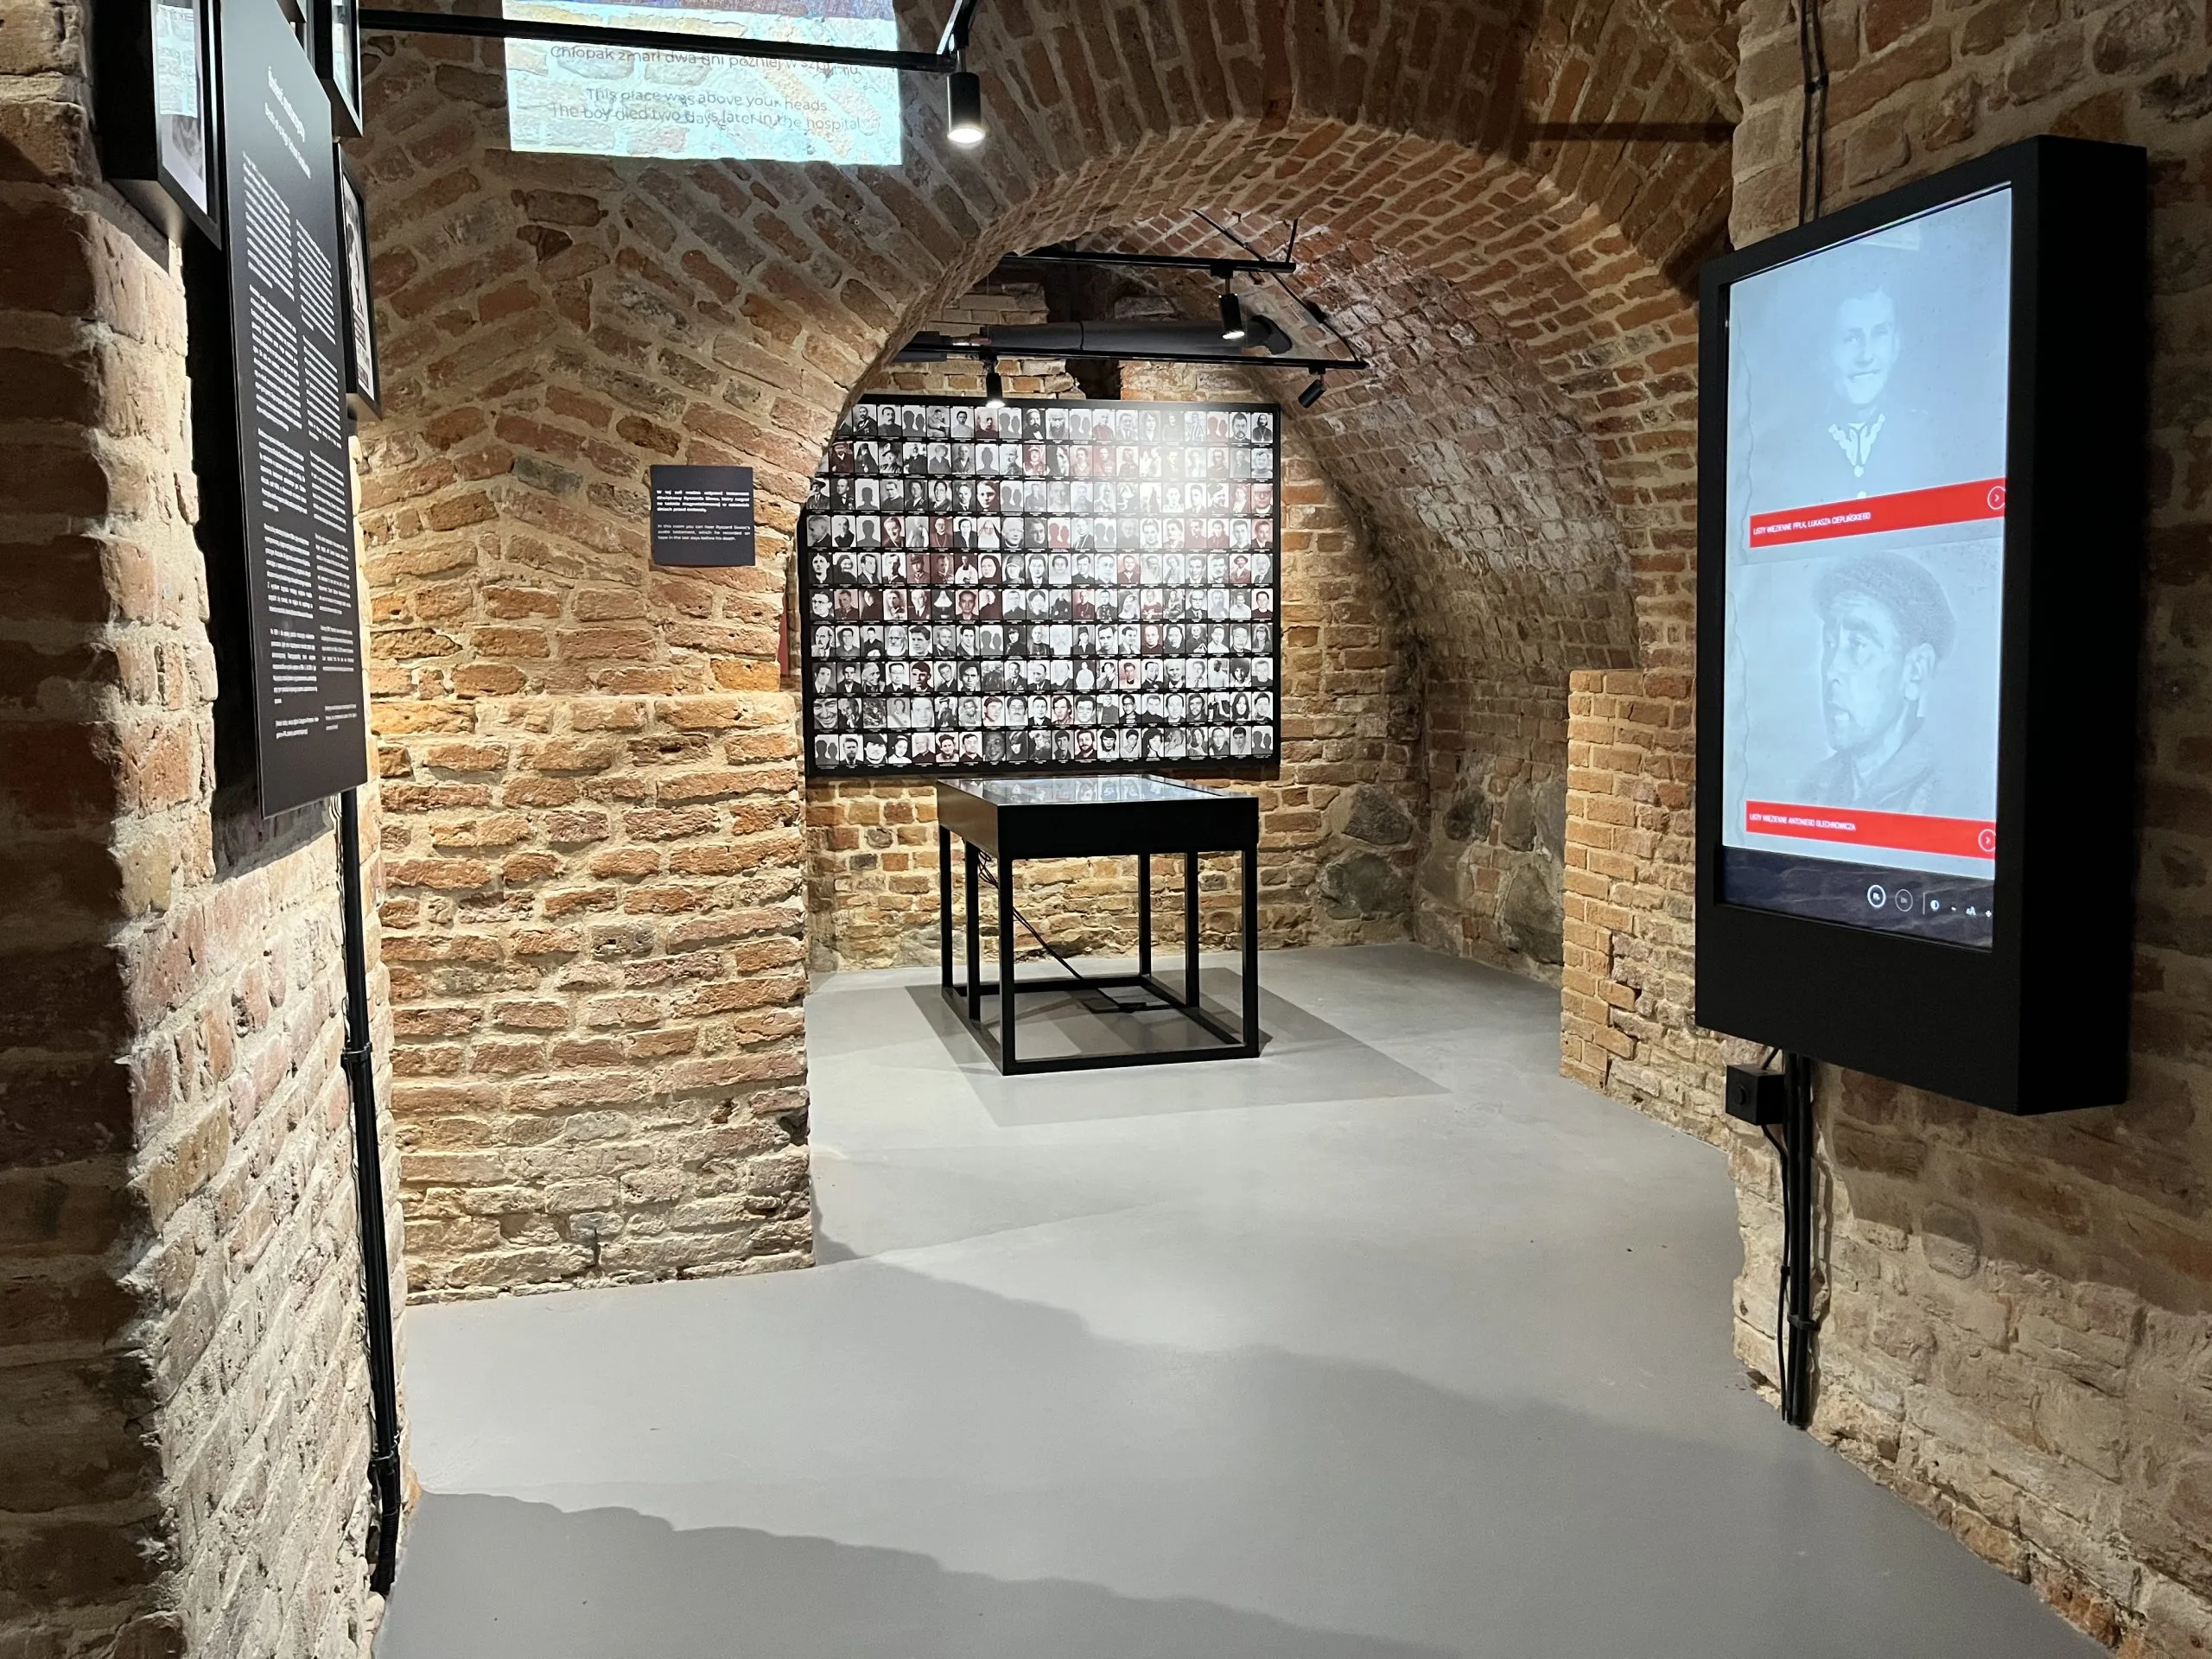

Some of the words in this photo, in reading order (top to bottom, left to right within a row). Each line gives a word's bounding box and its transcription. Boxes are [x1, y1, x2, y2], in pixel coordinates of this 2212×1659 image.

[664, 51, 696, 64] dwa
[701, 53, 723, 67] dni
[586, 88, 616, 102] This
[620, 90, 661, 105] place
[663, 92, 696, 105] was
[698, 92, 743, 106] above
[747, 95, 780, 108] your
[785, 98, 828, 111] heads
[551, 103, 579, 118] The
[584, 105, 613, 121] boy
[615, 106, 648, 121] died
[651, 109, 681, 123] two
[684, 110, 719, 127] days
[722, 110, 757, 124] later
[759, 112, 772, 124] in
[776, 112, 803, 129] the
[806, 115, 860, 130] hospital
